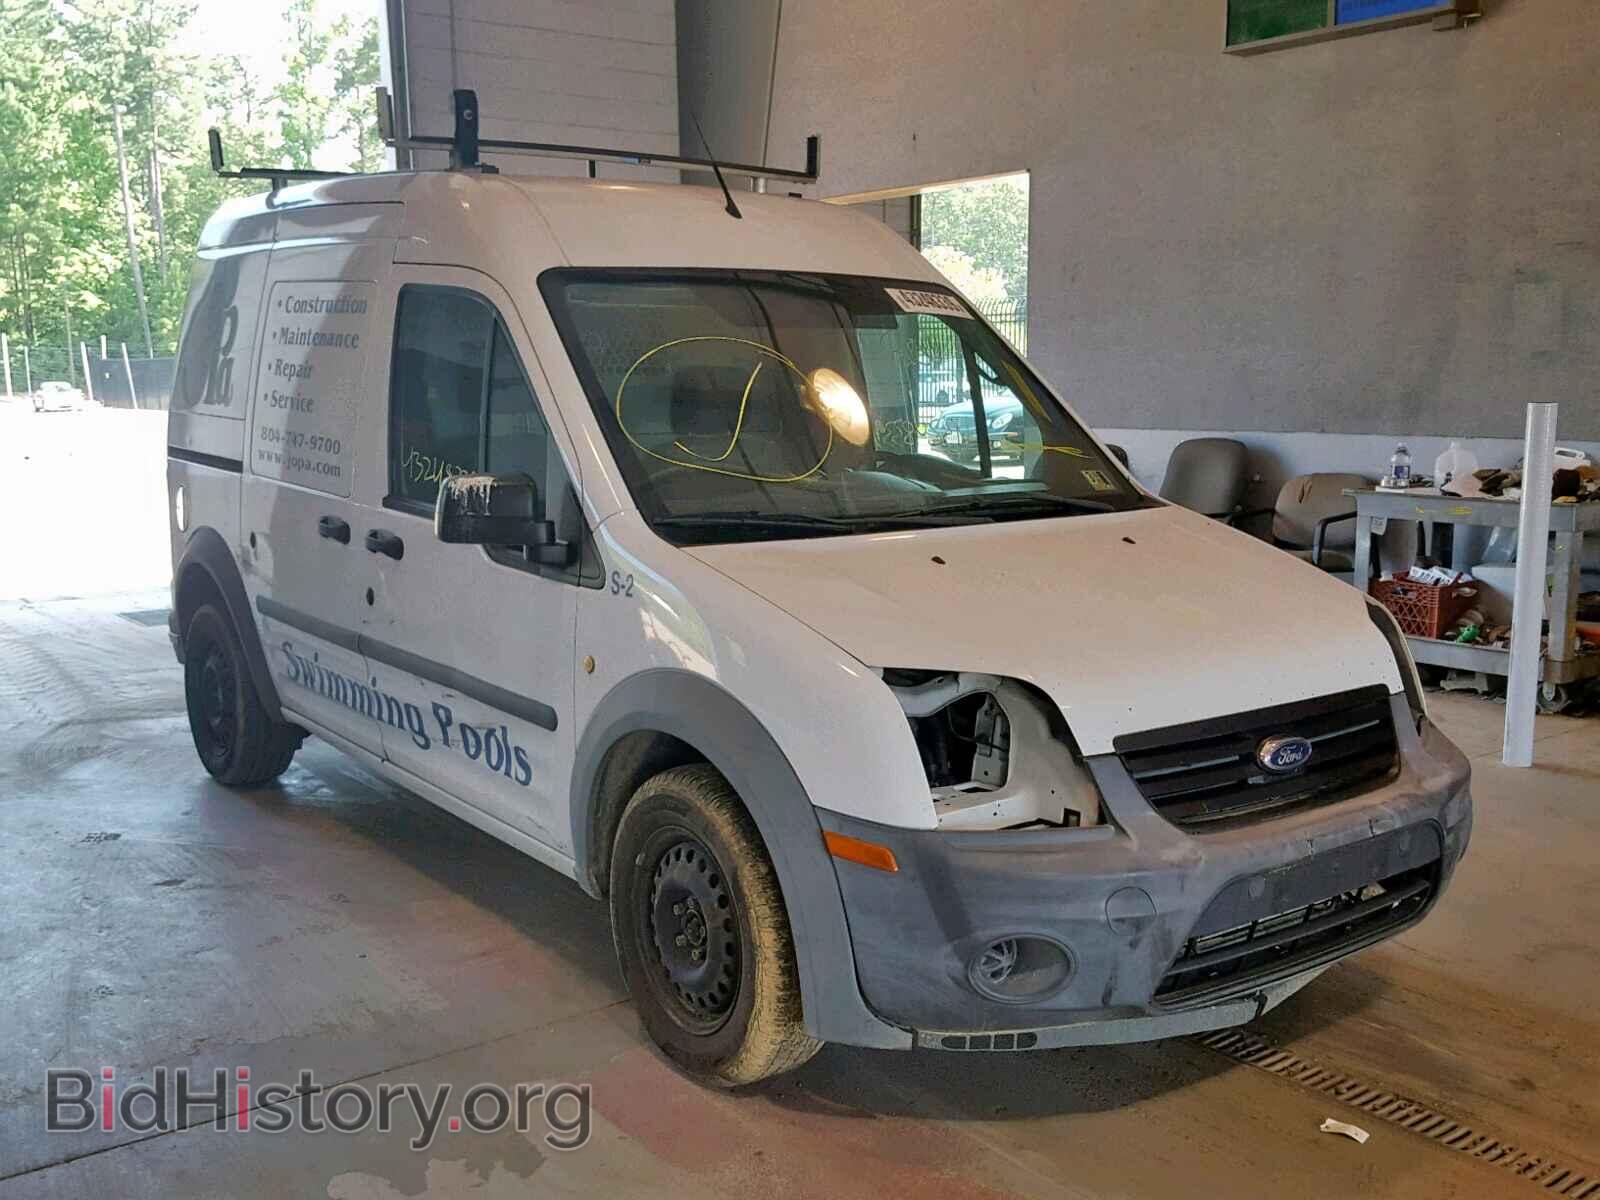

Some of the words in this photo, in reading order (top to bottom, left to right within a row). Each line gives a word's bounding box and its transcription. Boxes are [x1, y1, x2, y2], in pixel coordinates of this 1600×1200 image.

[285, 295, 367, 314] Construction
[279, 327, 359, 349] Maintenance
[274, 358, 313, 381] Repair
[269, 390, 314, 413] Service
[258, 449, 341, 477] www.jopa.com
[611, 571, 633, 597] S-2
[281, 641, 431, 750] Swimming
[432, 701, 532, 786] Pools
[1278, 743, 1303, 765] Ford
